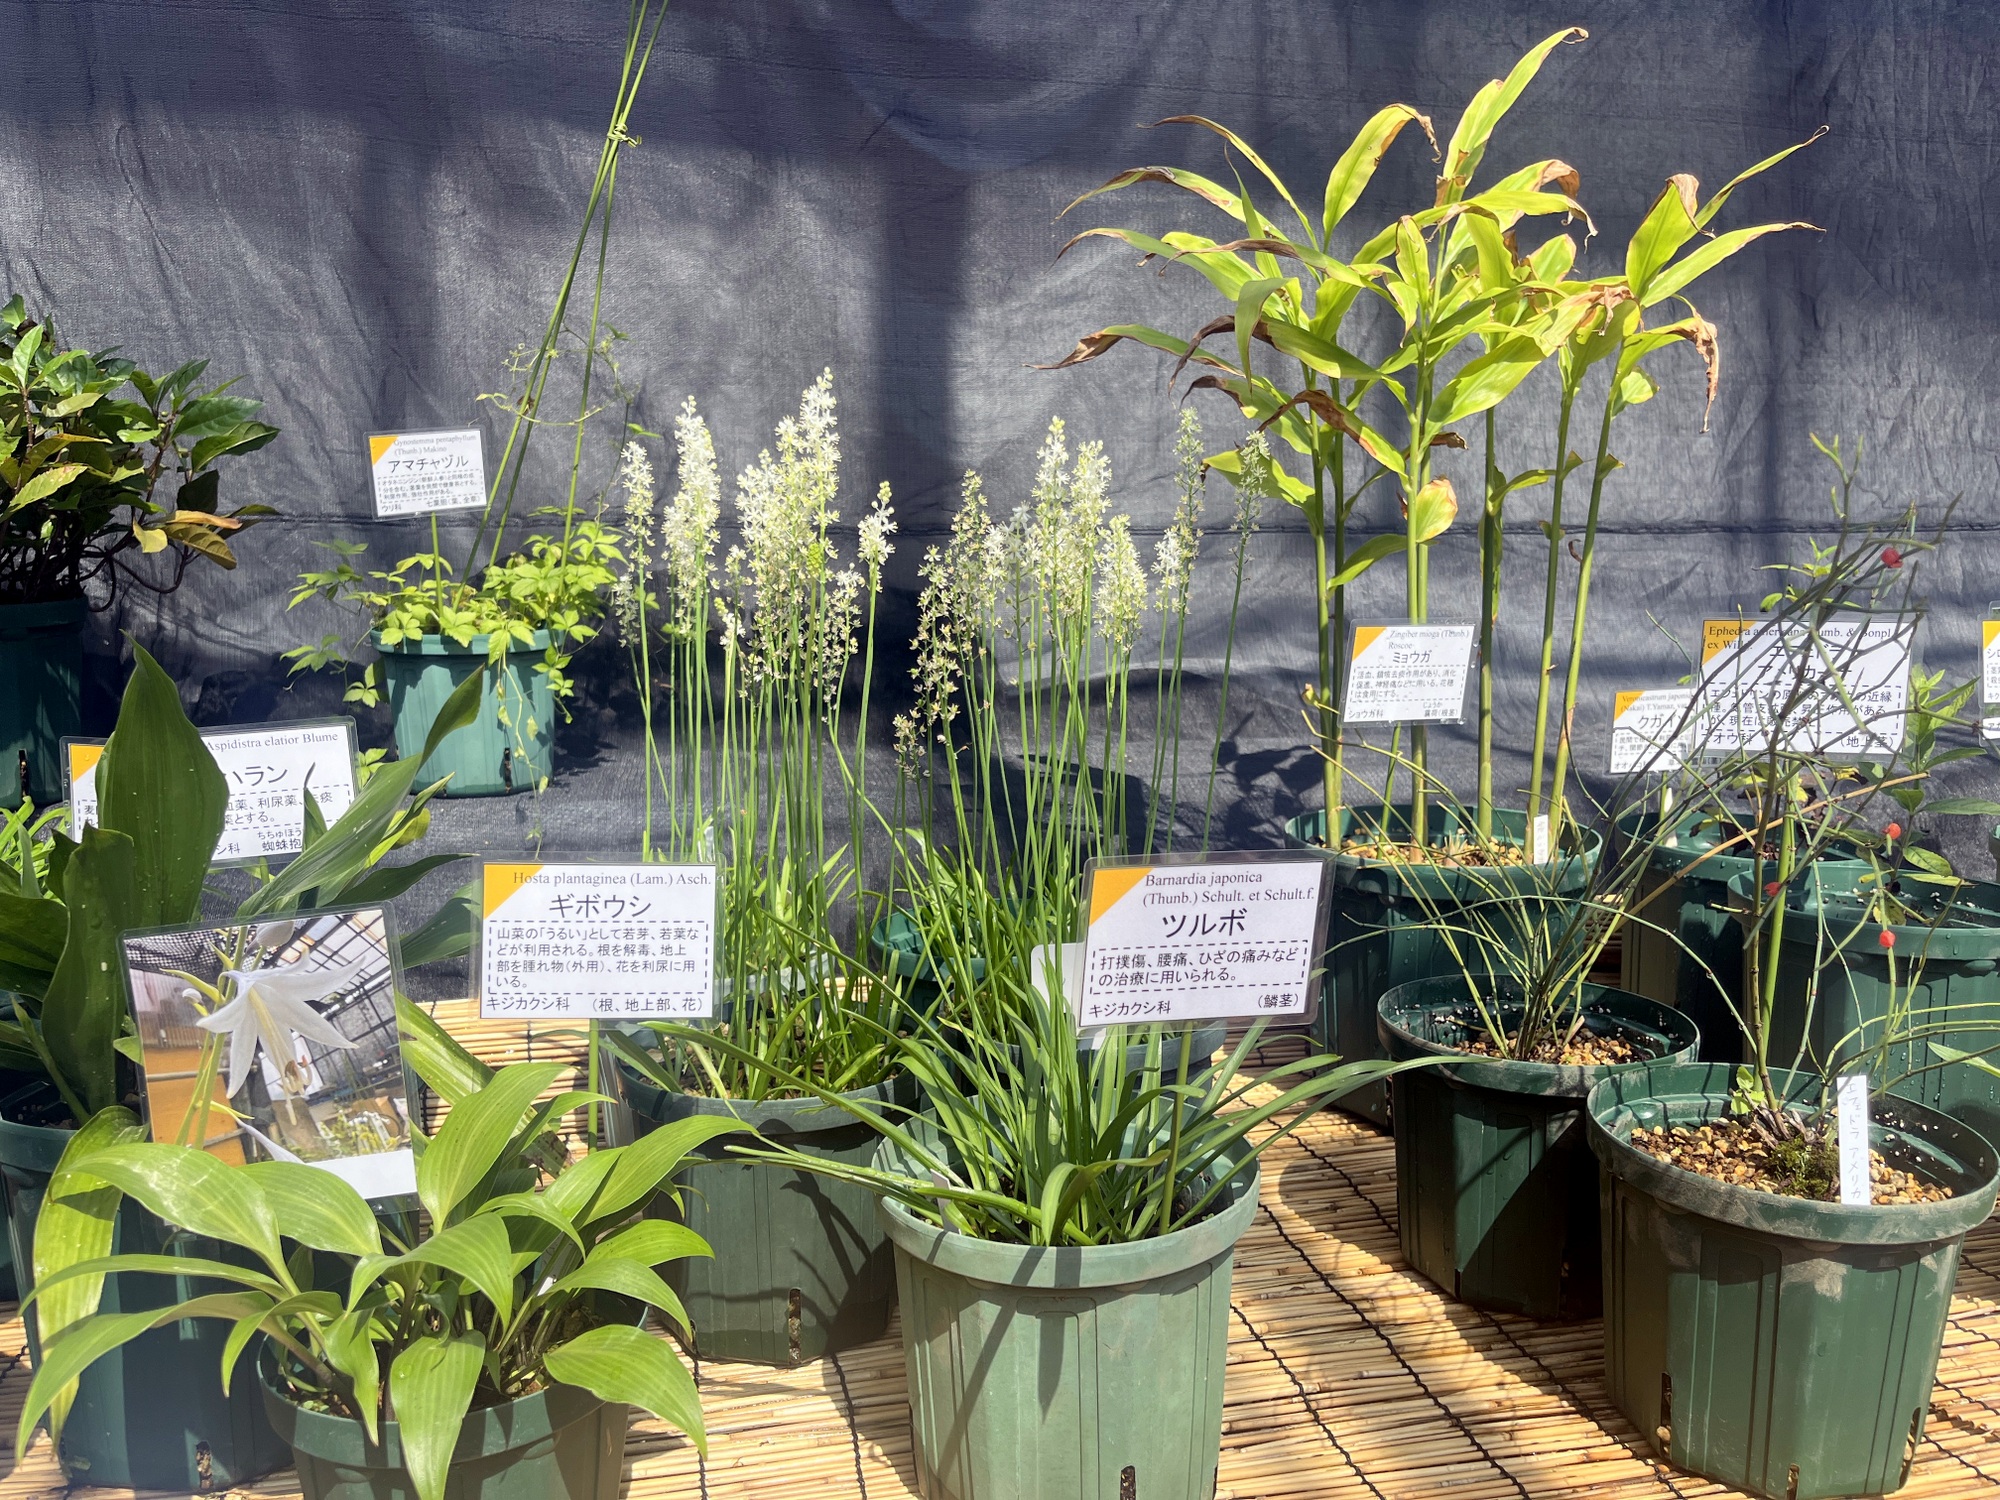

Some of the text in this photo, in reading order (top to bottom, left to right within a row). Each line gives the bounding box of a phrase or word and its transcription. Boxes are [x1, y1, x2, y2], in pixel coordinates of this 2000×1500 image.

[388, 454, 469, 473] アマチャヅル
[382, 504, 402, 512] ウリ科
[1390, 630, 1417, 639] Zingiber
[1419, 630, 1440, 639] mioga
[1388, 642, 1412, 650] Roscoe
[1393, 650, 1432, 664] ミョウガ
[1348, 709, 1384, 718] ショウガ科
[264, 735, 299, 746] elatior
[302, 732, 338, 744] Blume
[513, 872, 711, 888] Hosta plantaginea (Lam.) Asch.
[1146, 872, 1262, 888] Barnardia japonica
[1142, 888, 1315, 908] (Thunb.) Schult. et Schult.f.
[549, 894, 652, 918] ギボウシ
[1162, 908, 1248, 938] ツルボ
[497, 927, 699, 940] 山菜の「うるい」として若芽、若葉な
[496, 944, 686, 957] どが利用される。根を解毒、地上
[1100, 947, 1298, 970] 打撲傷、腰痛、ひざの痛みなど
[496, 960, 695, 974] 部を腫れ物（外用）、花を利尿に用
[496, 976, 528, 988] いる。
[1098, 968, 1237, 987] の治療に用いられる。
[486, 997, 704, 1012] キジカクシ科 （根、地上部、花）
[1088, 993, 1300, 1018] キジカクシ科 （鱗茎）
